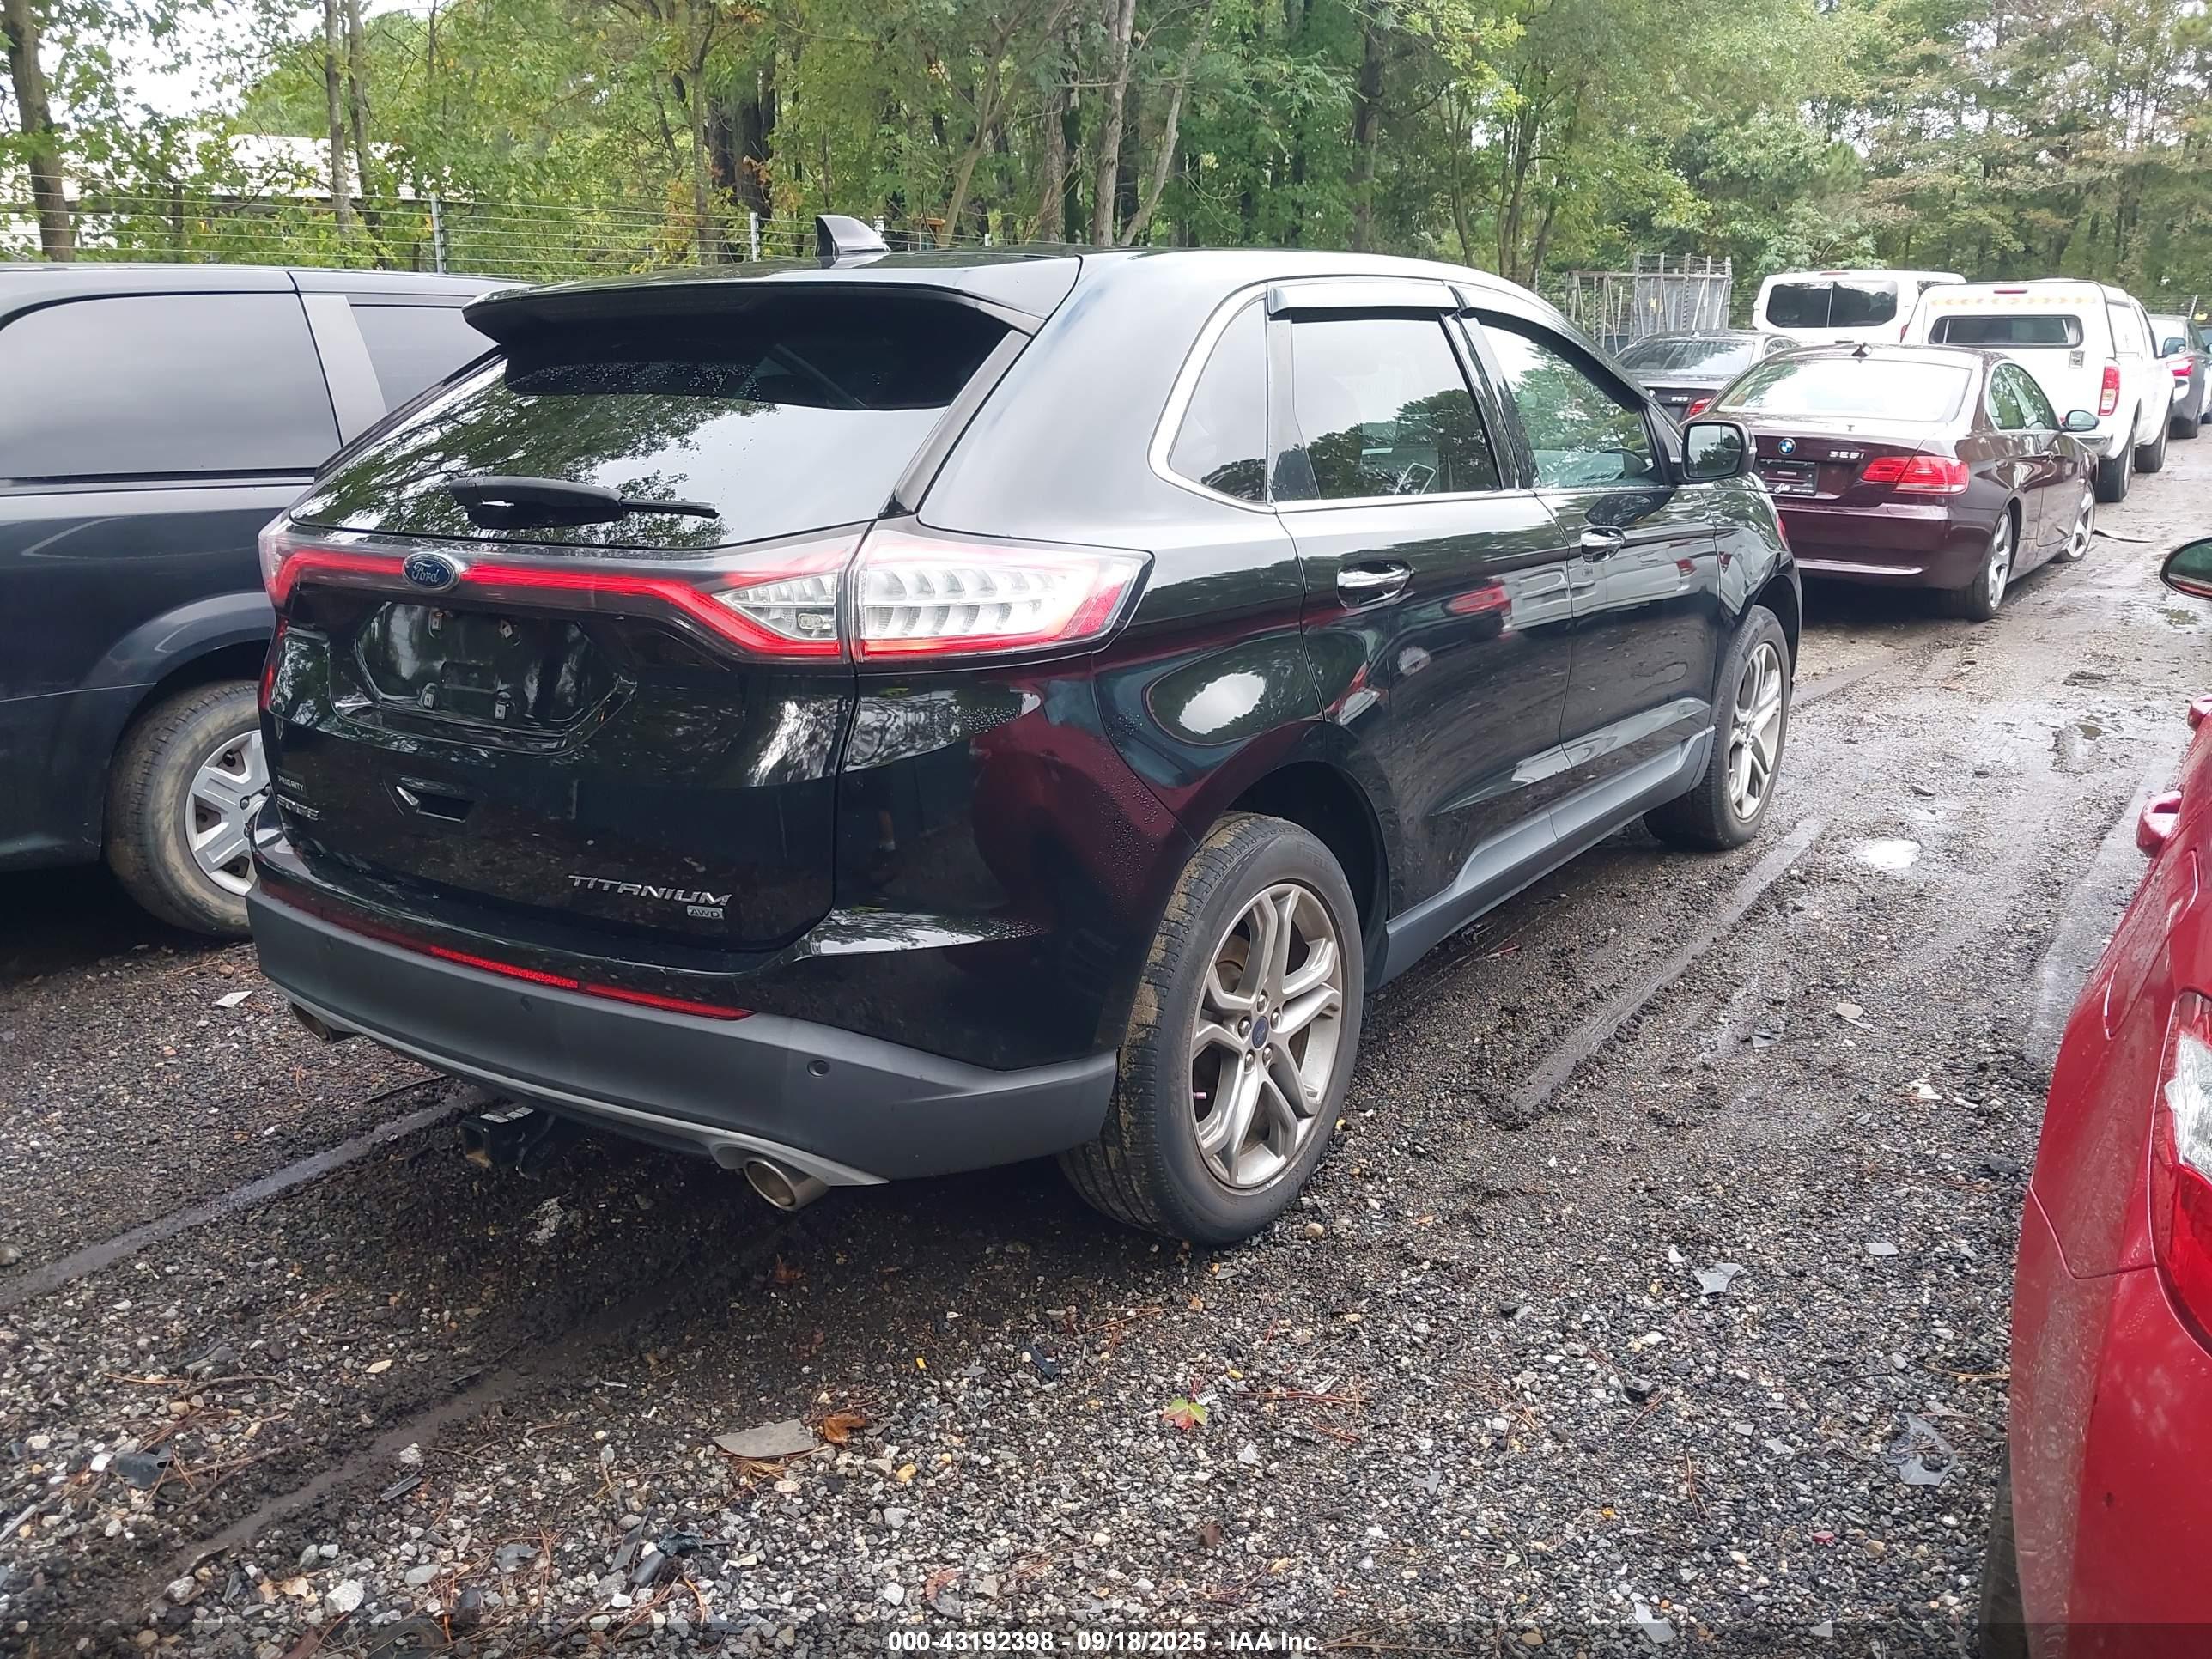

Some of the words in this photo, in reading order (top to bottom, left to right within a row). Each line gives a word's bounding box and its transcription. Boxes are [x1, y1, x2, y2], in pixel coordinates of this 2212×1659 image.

[412, 562, 441, 583] Ford
[277, 775, 304, 791] PRIORITY
[276, 794, 319, 821] EDGE
[568, 875, 732, 906] TITANIUM
[690, 908, 721, 919] AWD
